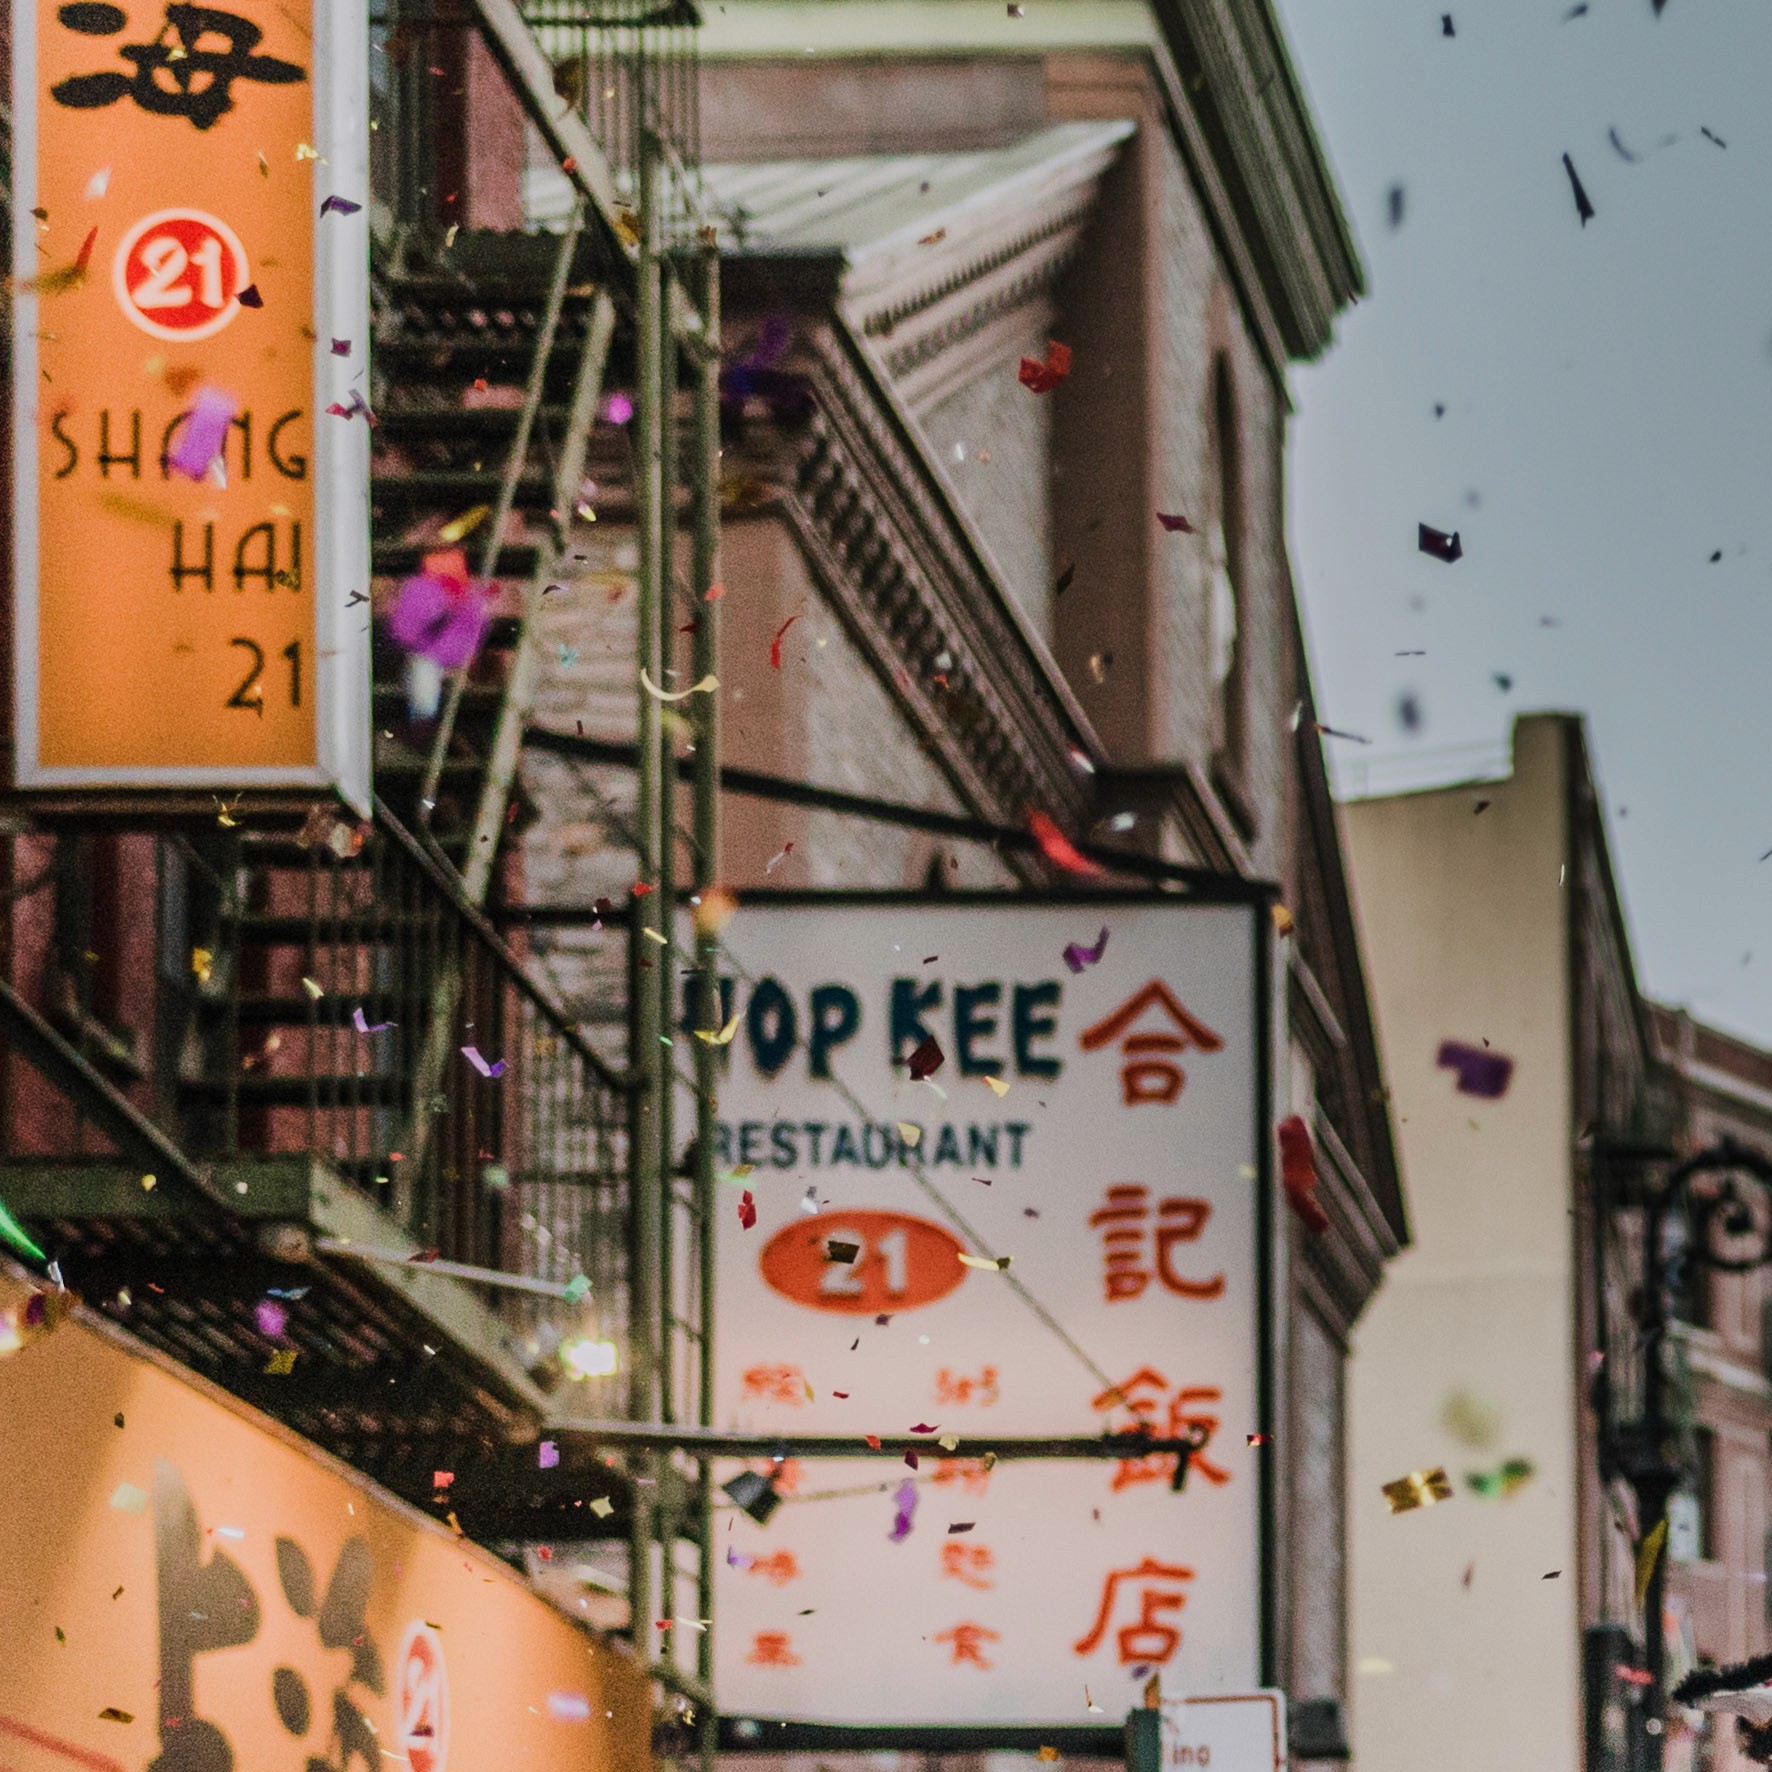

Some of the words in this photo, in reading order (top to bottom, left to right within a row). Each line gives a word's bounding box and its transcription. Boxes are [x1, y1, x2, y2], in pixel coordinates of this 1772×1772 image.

[132, 236, 225, 309] 21
[170, 520, 301, 593] HAI
[226, 636, 301, 710] 21
[888, 975, 1063, 1081] KEE
